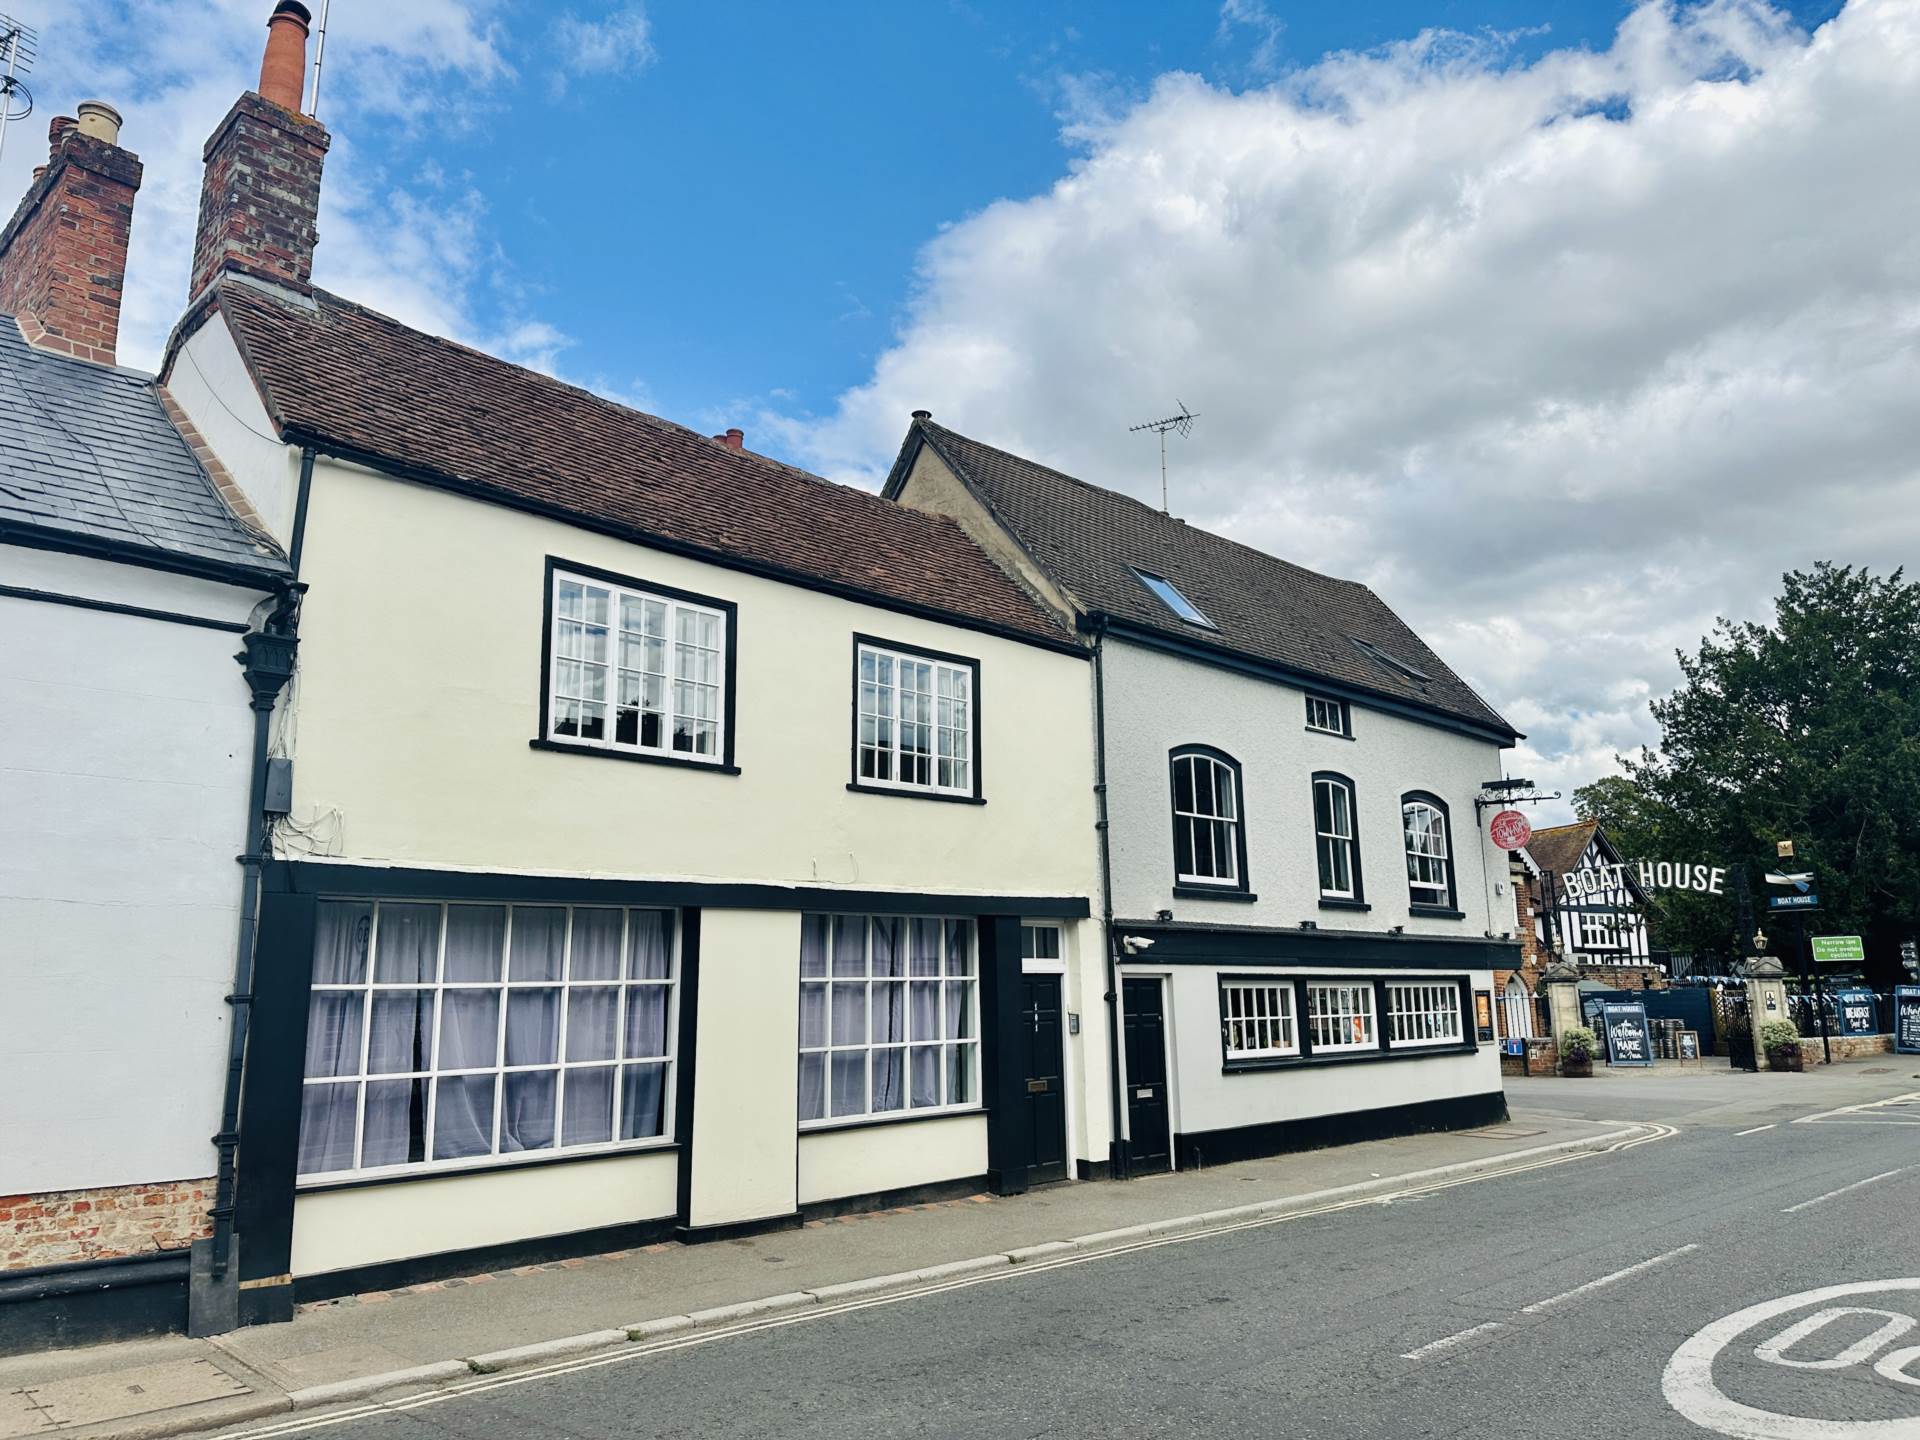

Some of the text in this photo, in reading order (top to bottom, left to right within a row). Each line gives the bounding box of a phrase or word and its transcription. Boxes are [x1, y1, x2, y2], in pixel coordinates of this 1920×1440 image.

[1562, 861, 1726, 898] BOAT HOUSE
[1777, 896, 1812, 905] BOAT HOUSE
[1901, 987, 1916, 996] BOAT
